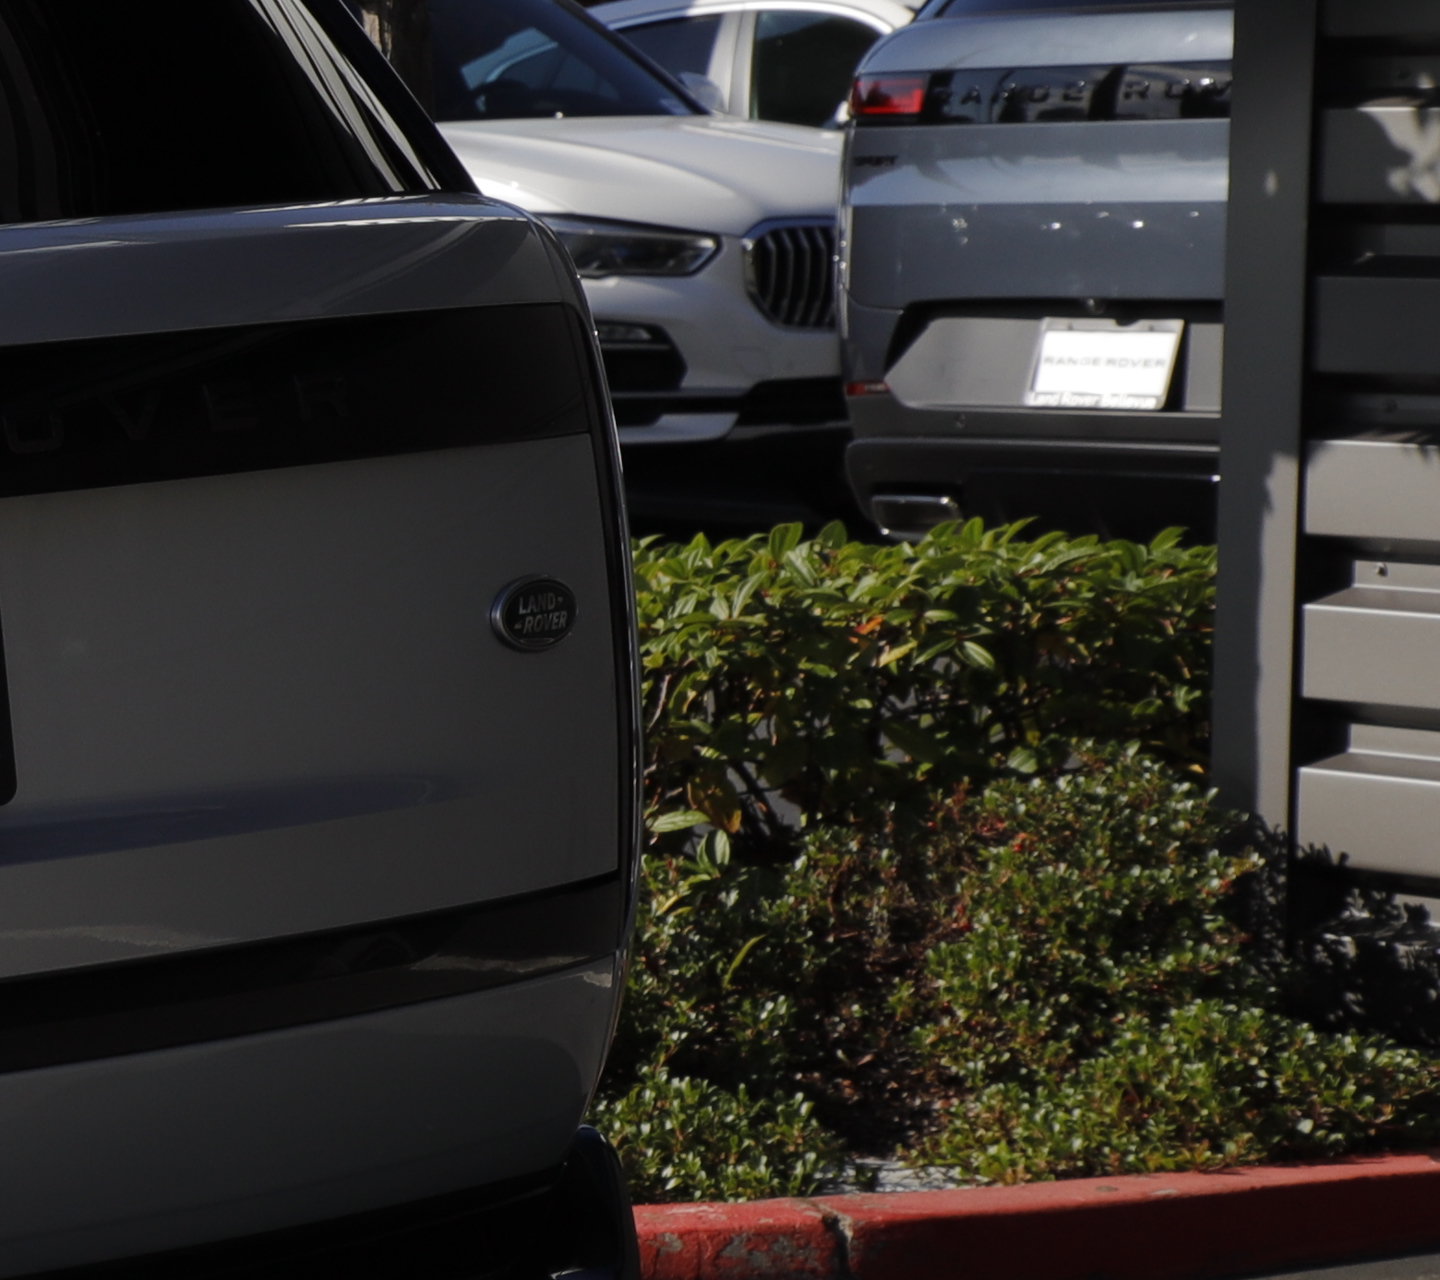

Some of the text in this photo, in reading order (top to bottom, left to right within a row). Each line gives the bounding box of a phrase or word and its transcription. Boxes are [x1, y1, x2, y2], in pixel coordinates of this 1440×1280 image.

[1043, 354, 1167, 369] RANGE ROVER
[518, 592, 556, 615] LAND
[522, 610, 568, 634] ROVER
